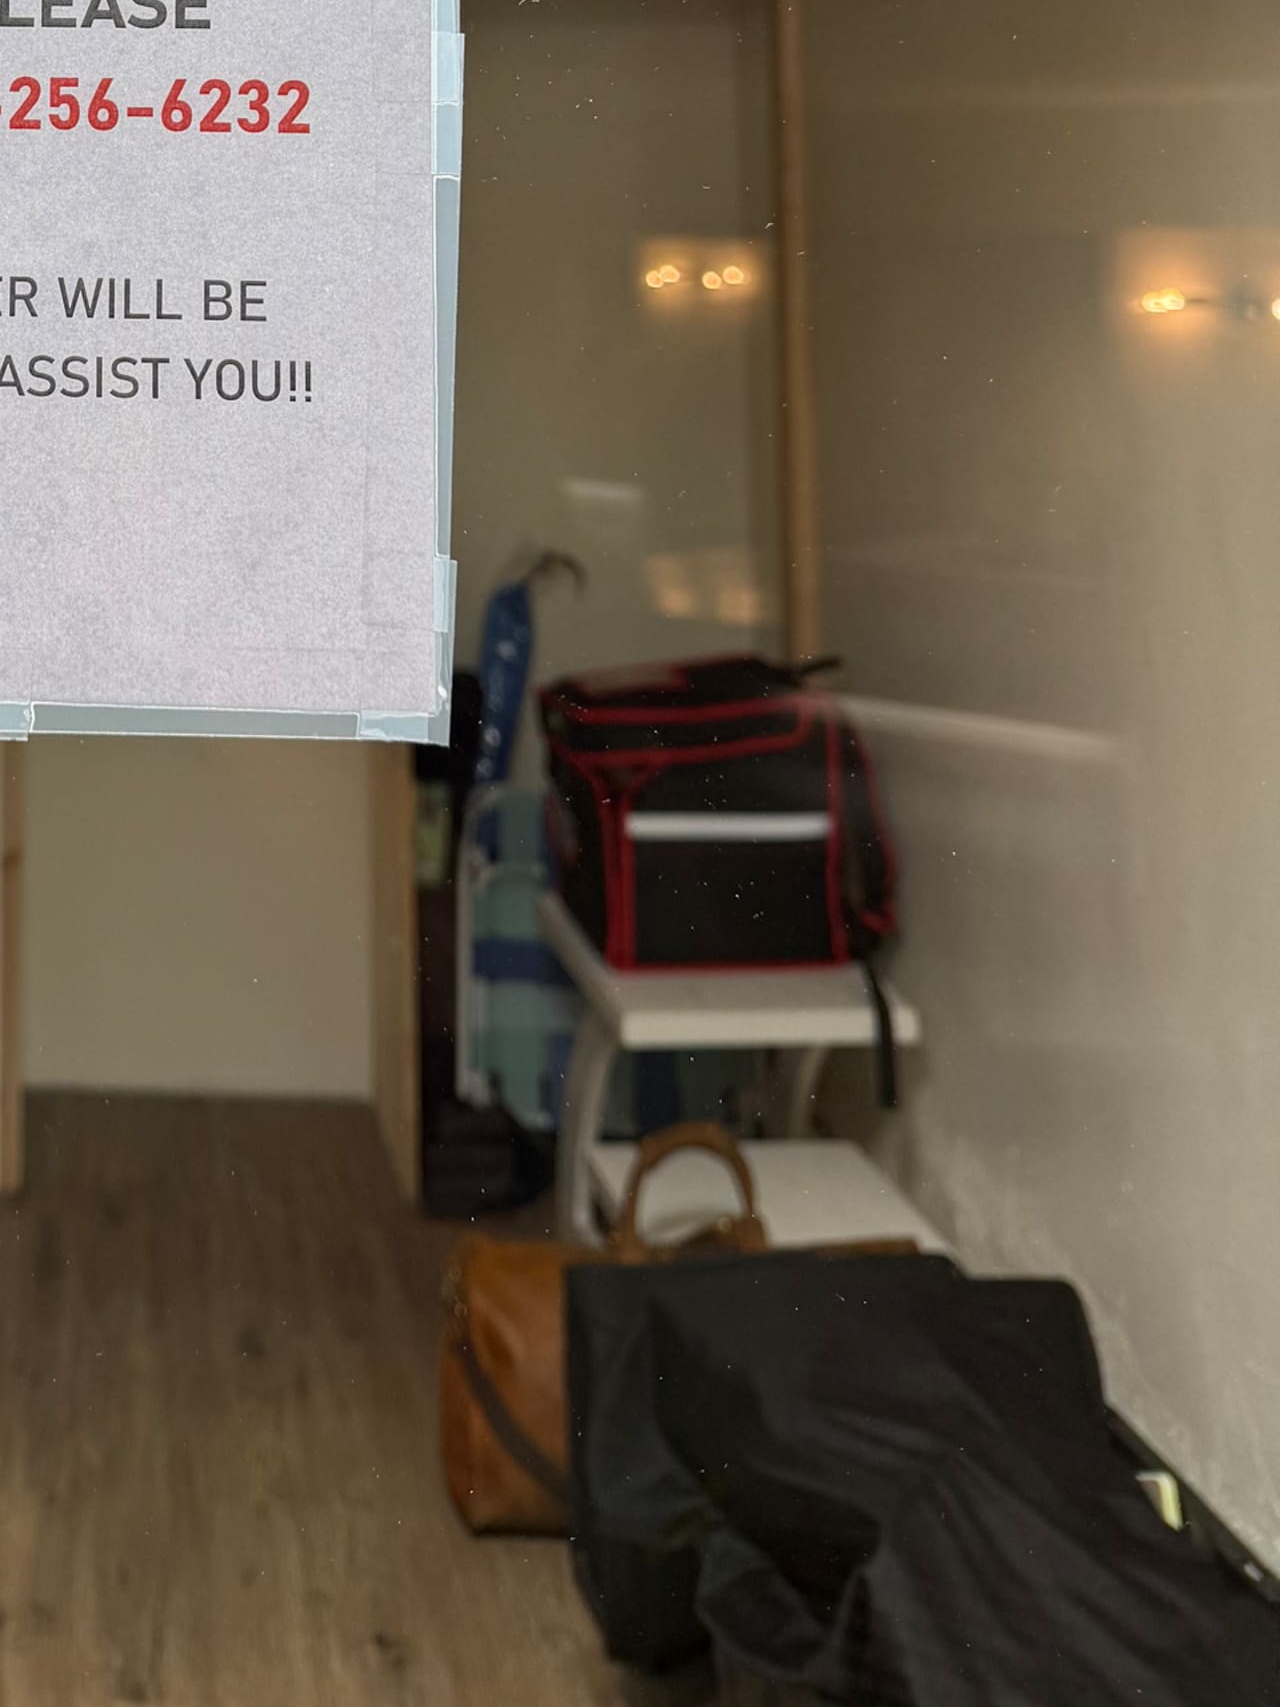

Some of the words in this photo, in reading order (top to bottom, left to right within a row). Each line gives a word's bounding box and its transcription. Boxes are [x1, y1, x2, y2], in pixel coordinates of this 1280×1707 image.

[58, 277, 182, 320] WILL
[204, 280, 267, 322] BE
[184, 358, 312, 403] YOU!!
